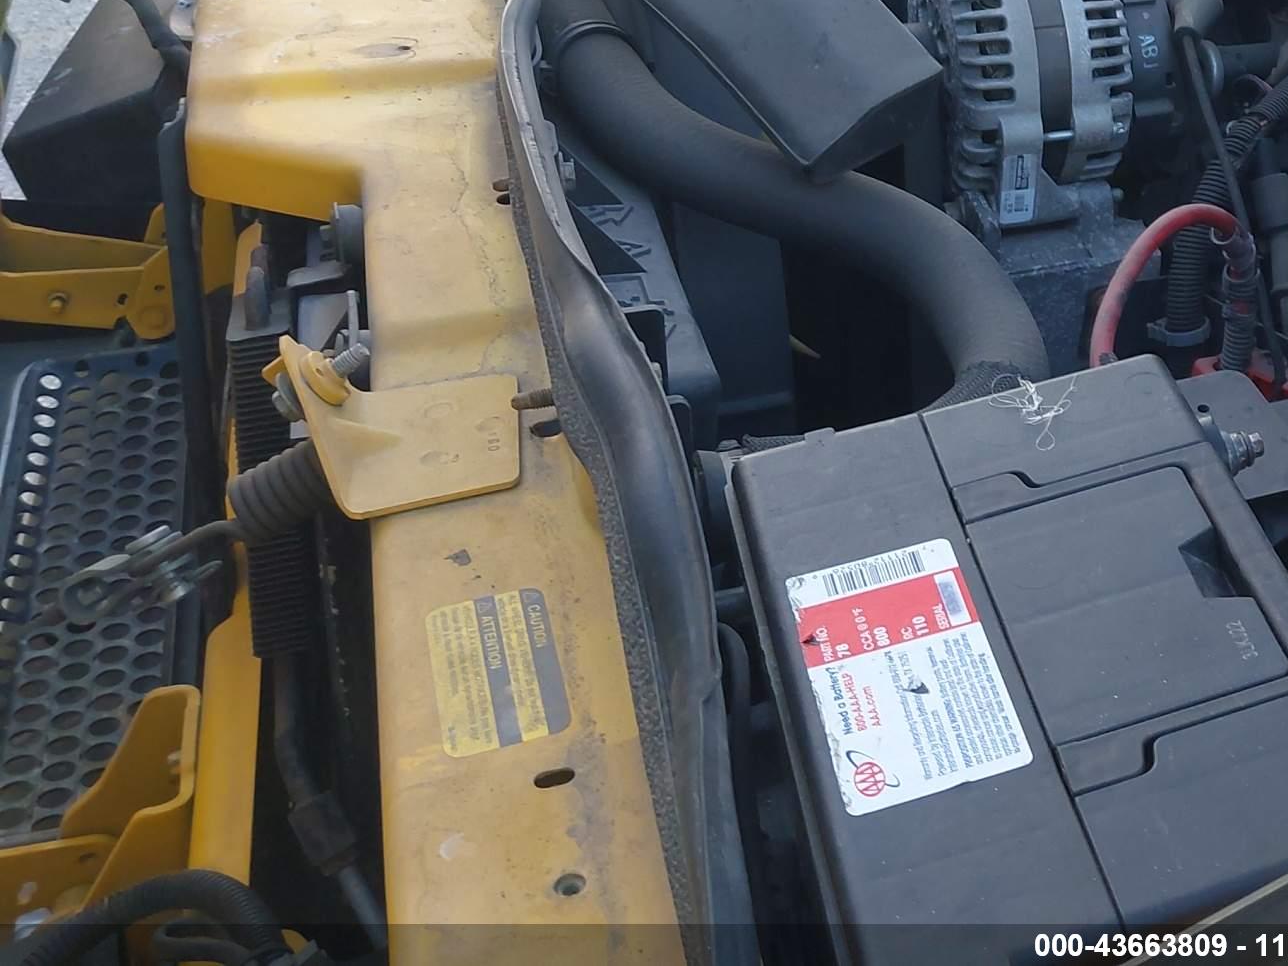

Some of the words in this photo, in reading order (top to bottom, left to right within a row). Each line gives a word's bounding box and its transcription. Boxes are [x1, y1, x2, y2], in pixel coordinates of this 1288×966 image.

[528, 604, 548, 648] CAUTION
[873, 626, 890, 647] 800
[900, 627, 914, 640] RC
[912, 616, 930, 635] 110
[480, 615, 502, 669] ATTENTION
[821, 643, 834, 661] PART
[835, 643, 850, 658] 78
[859, 631, 875, 651] CCA
[826, 666, 845, 701] Battery?
[843, 673, 867, 731] 800-AAA-HELP
[862, 686, 882, 727] AAA.com
[839, 711, 853, 735] Need
